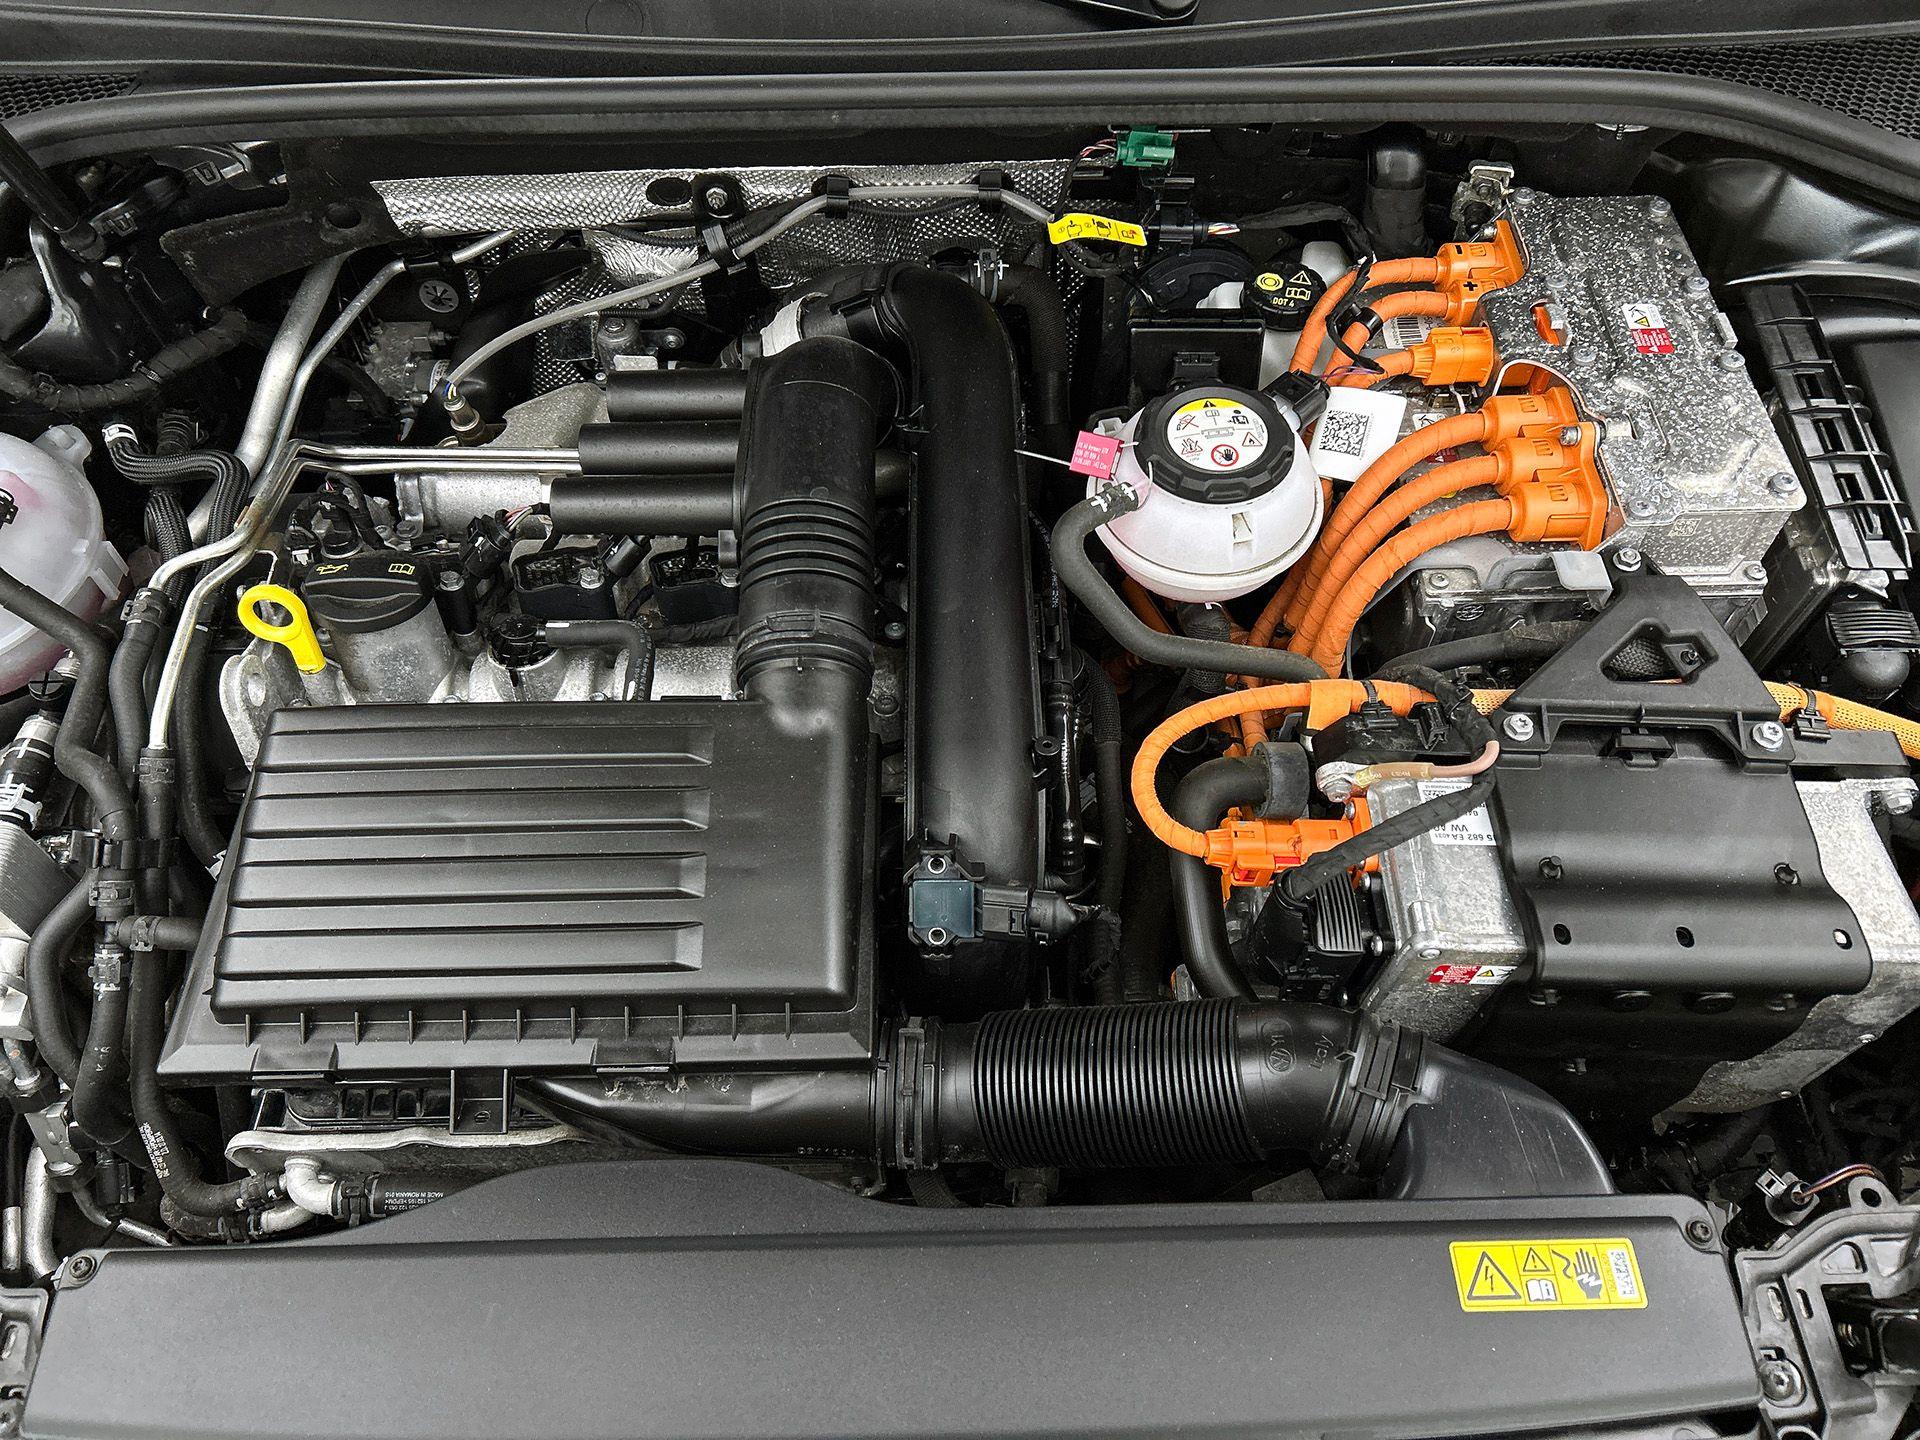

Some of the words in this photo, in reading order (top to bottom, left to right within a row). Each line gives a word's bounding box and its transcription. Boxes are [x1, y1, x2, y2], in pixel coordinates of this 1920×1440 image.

[1272, 297, 1288, 306] DOT
[1451, 824, 1469, 832] VW
[1309, 1034, 1334, 1072] Italy
